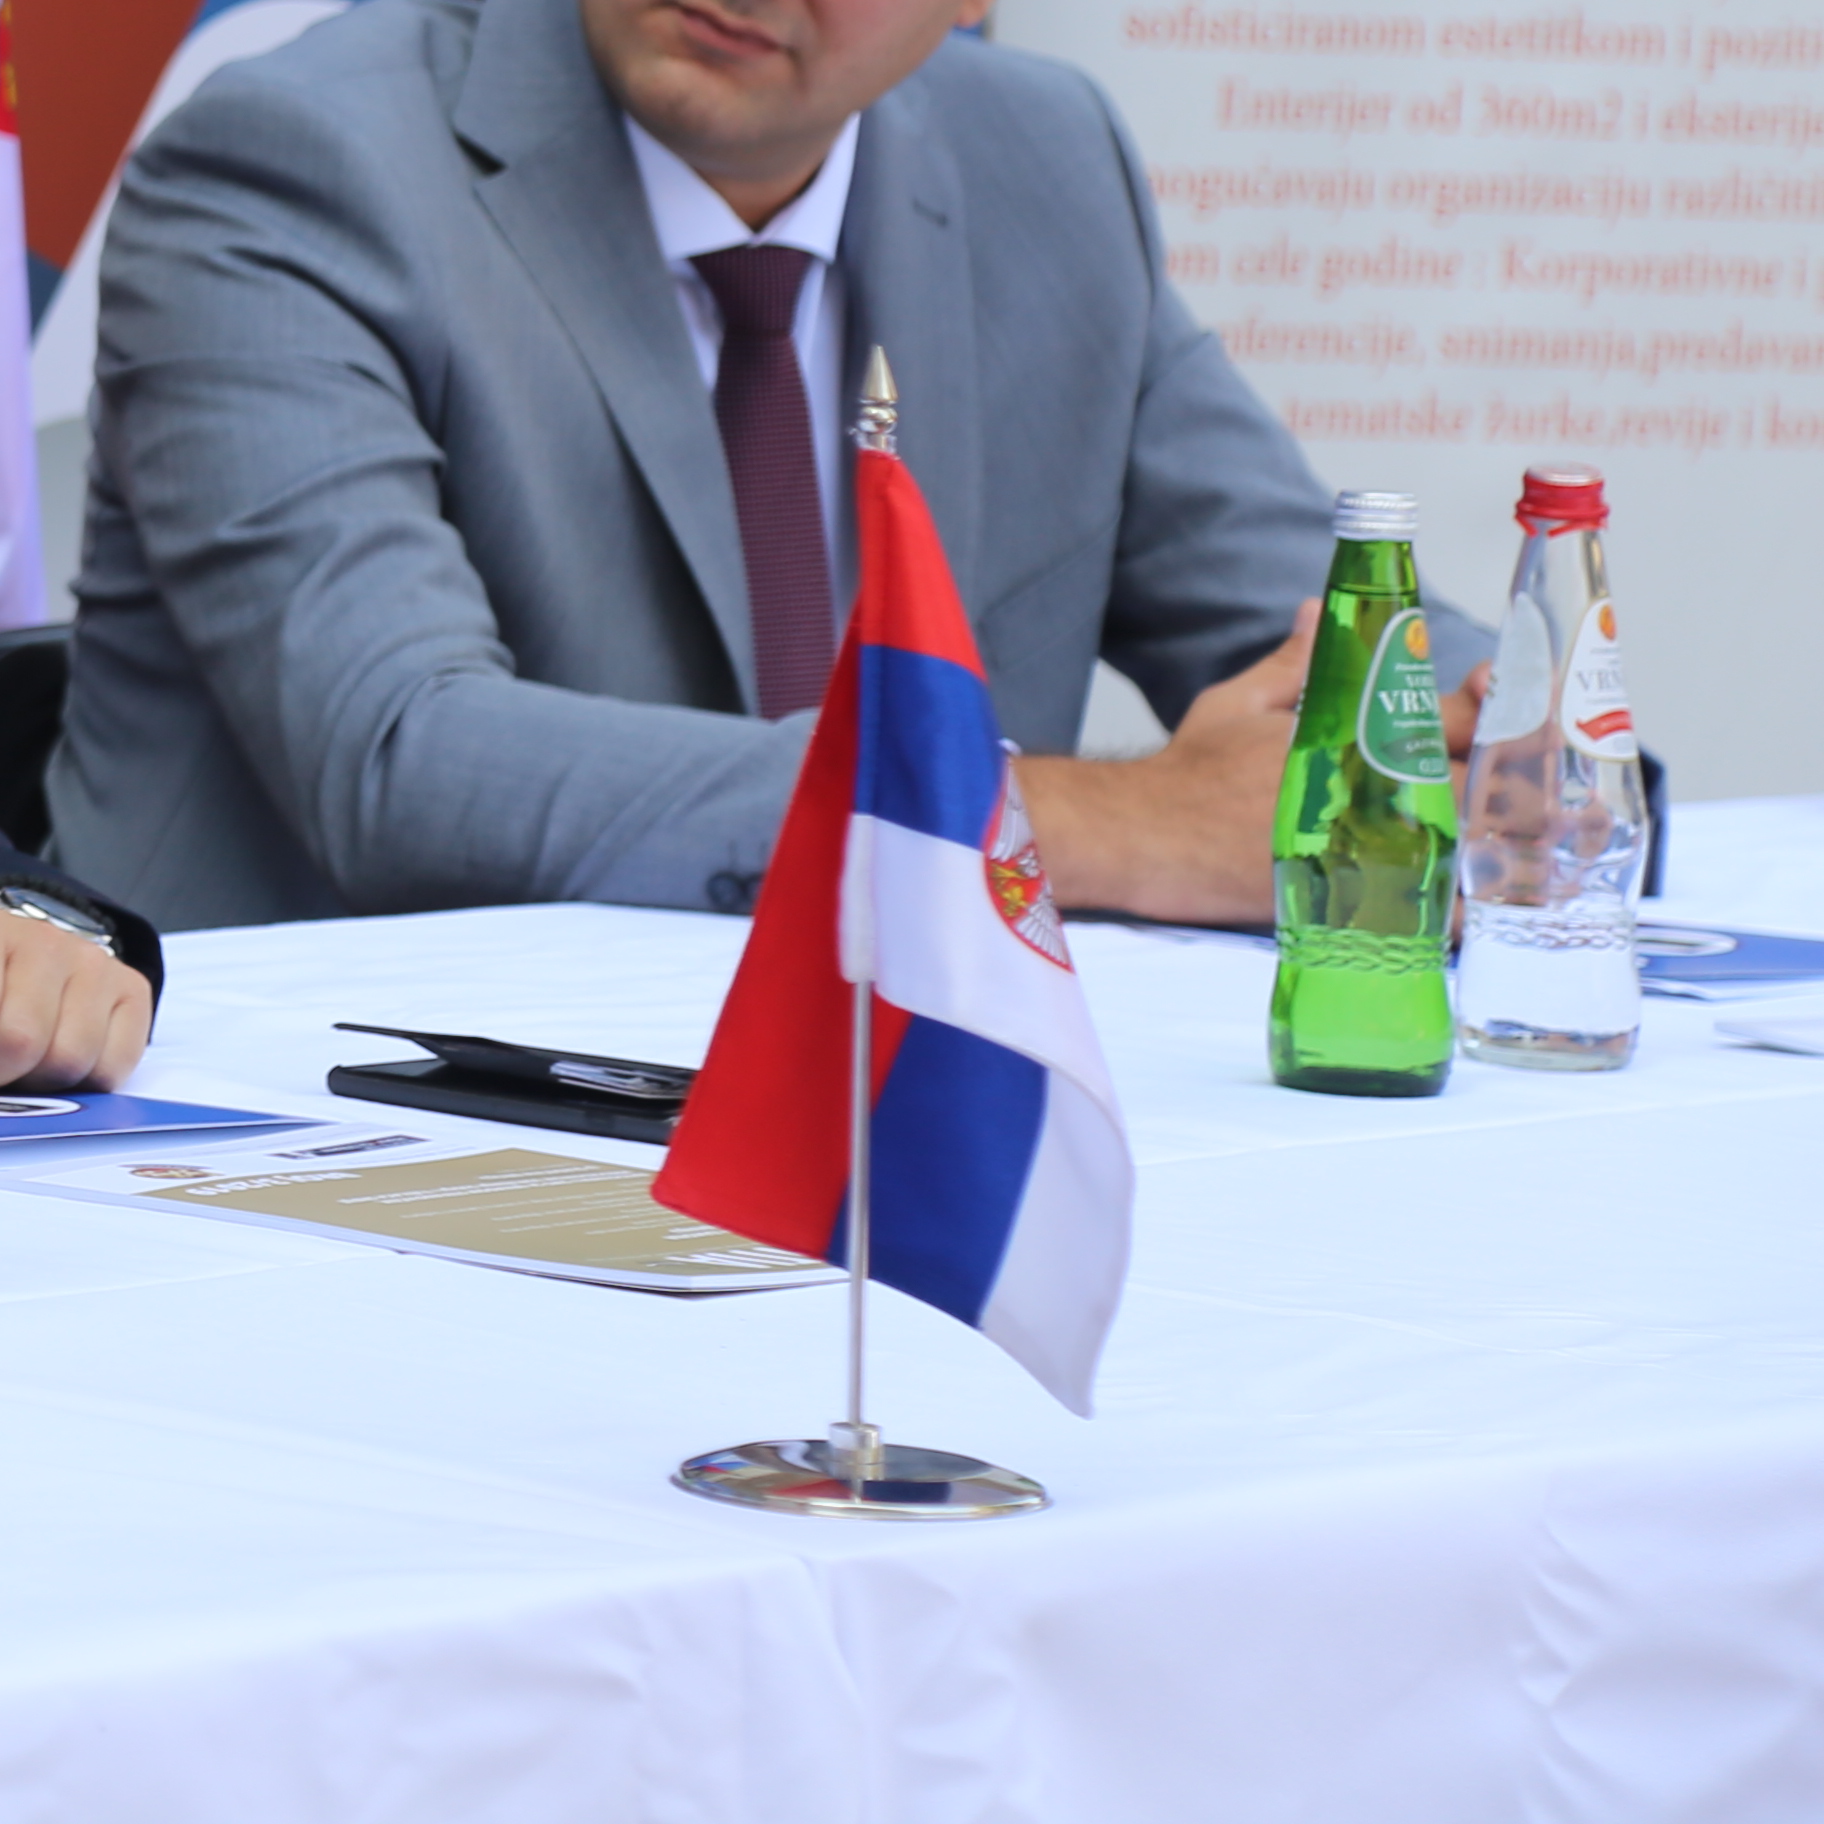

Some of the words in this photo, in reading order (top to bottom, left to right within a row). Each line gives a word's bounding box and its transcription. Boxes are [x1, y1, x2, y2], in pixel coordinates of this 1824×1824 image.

[1675, 12, 1692, 68] i
[1217, 74, 1395, 143] Enterijer
[1407, 77, 1464, 136] od
[1630, 88, 1649, 142] i
[1384, 161, 1651, 231] organizaciju
[1230, 229, 1308, 286] cele
[1312, 229, 1462, 303] godine
[1498, 238, 1782, 309] Korporativne
